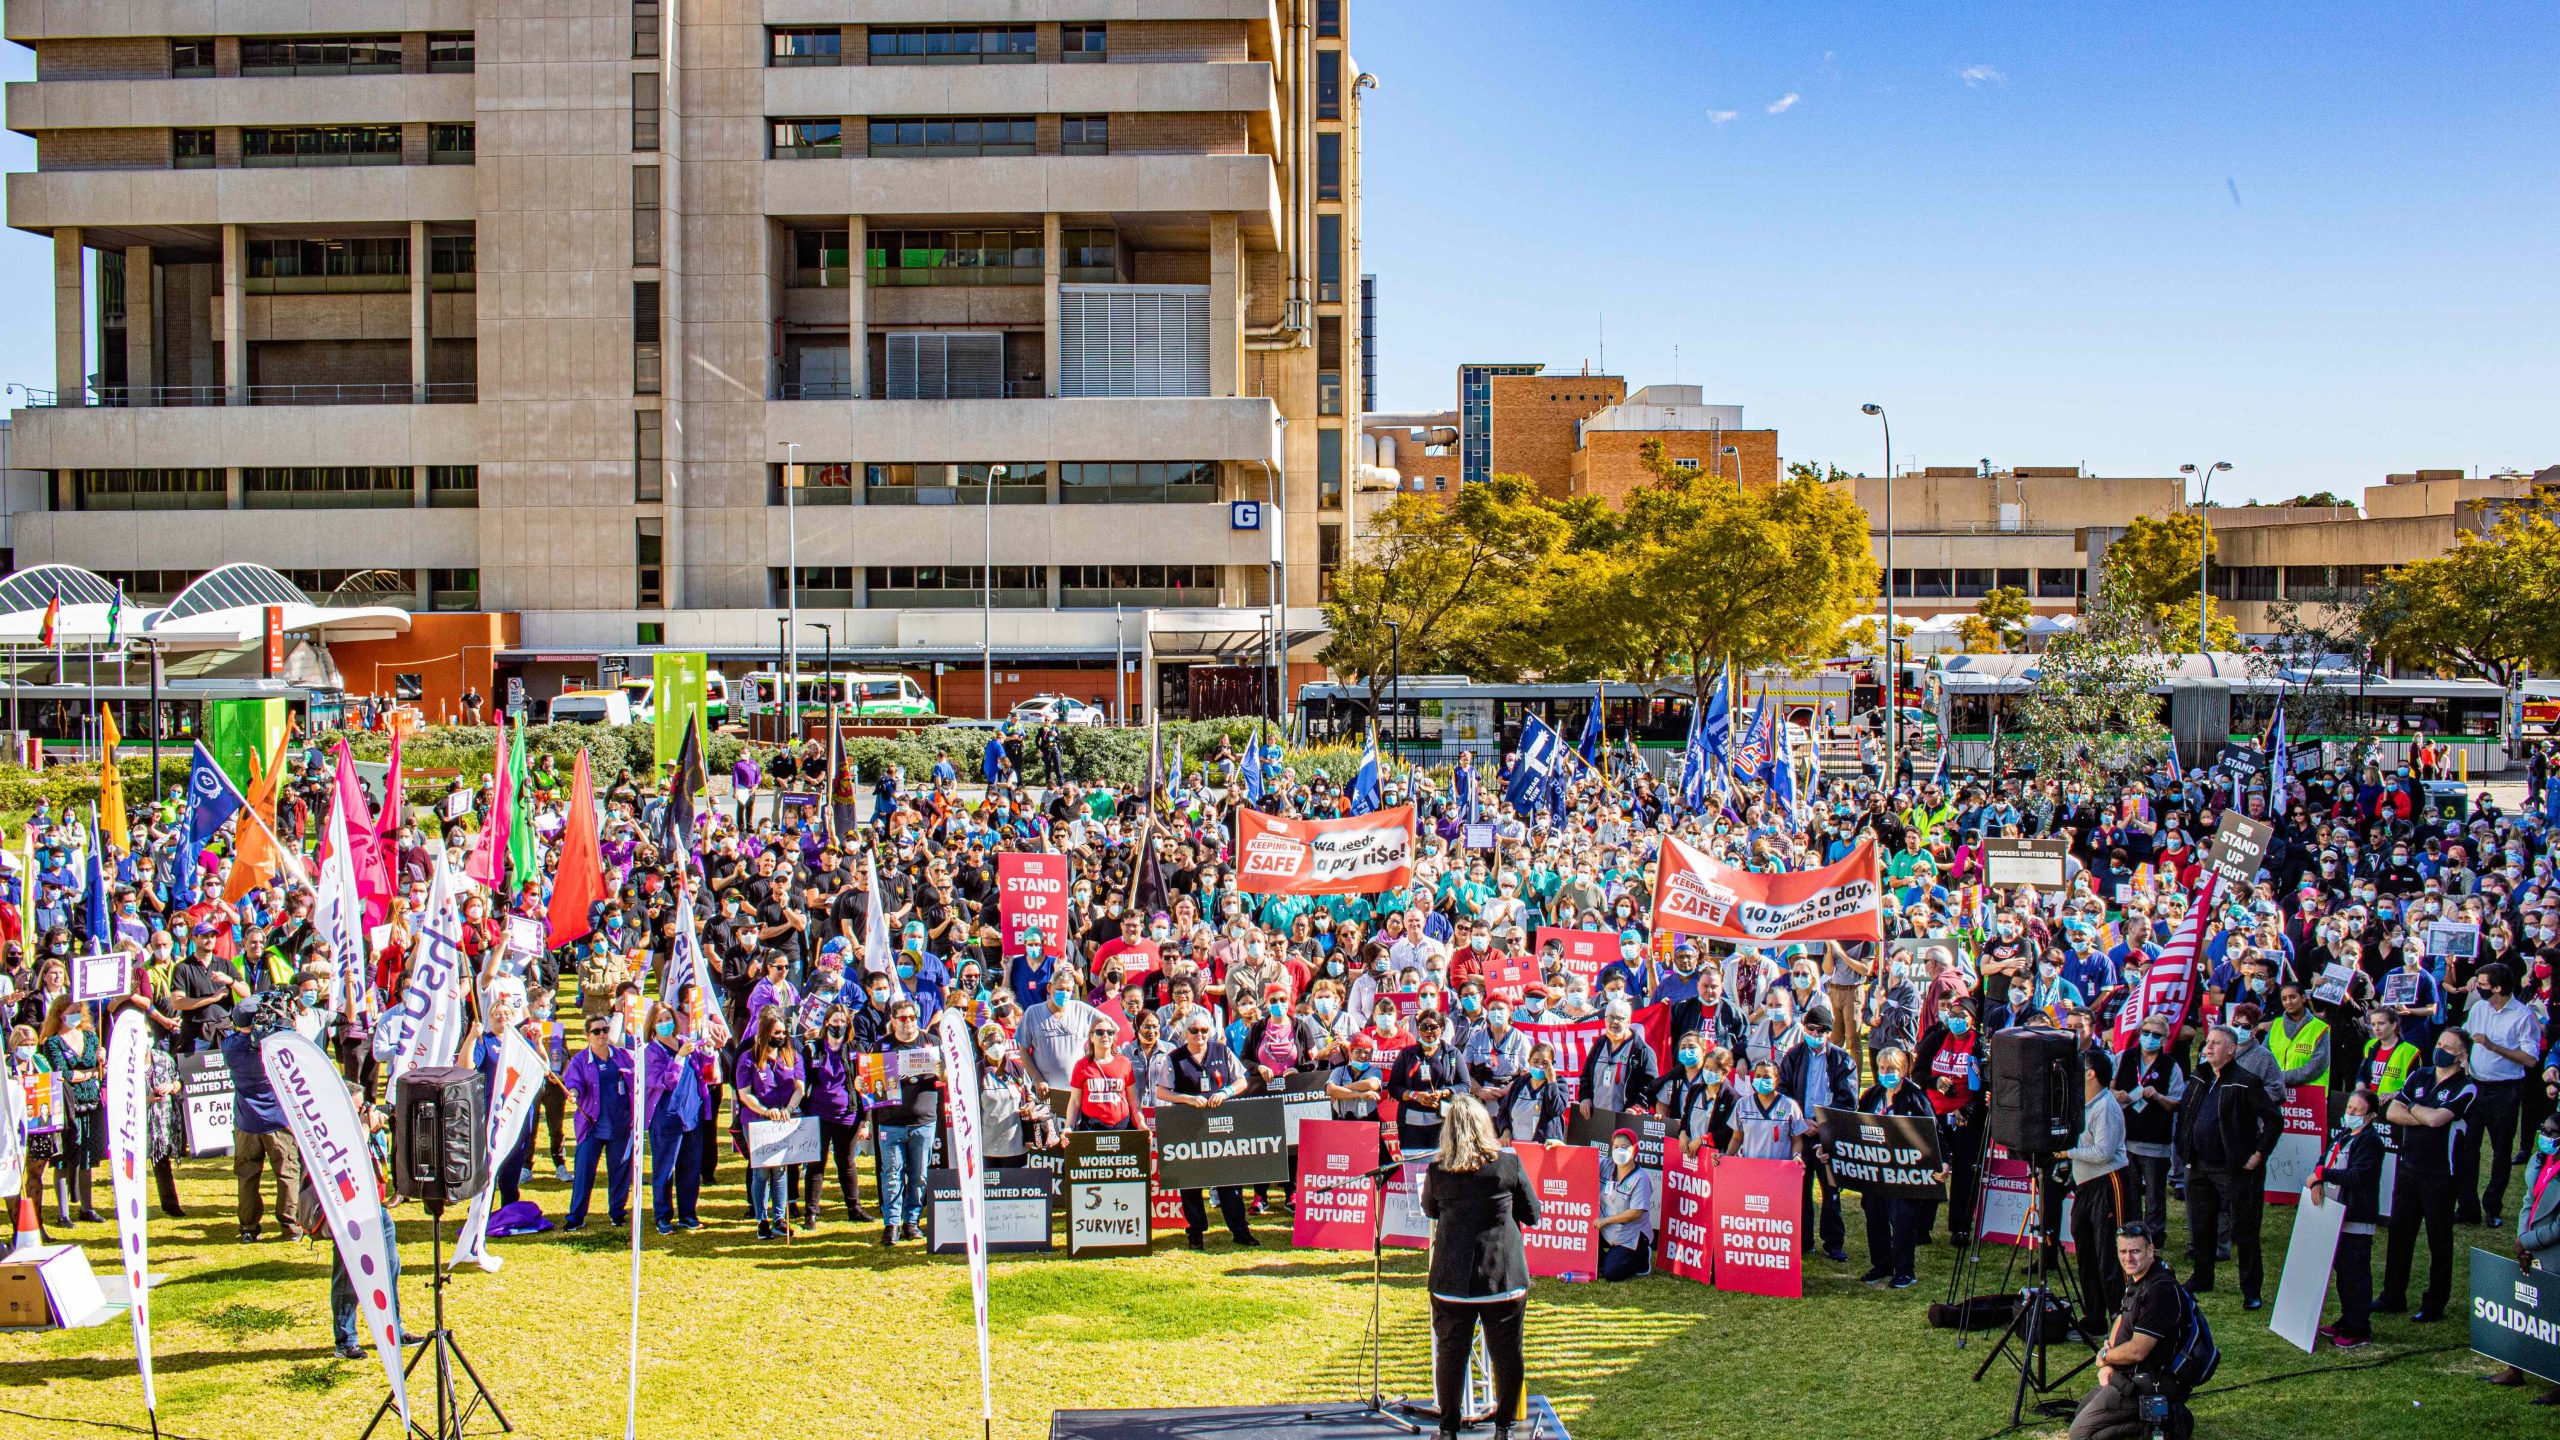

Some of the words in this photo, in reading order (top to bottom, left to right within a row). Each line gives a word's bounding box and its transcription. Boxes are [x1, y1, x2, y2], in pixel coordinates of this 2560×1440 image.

[1235, 504, 1257, 527] G
[2224, 757, 2256, 775] STAND
[1251, 840, 1287, 851] KEEPING
[1314, 841, 1335, 852] WA
[2220, 830, 2260, 857] STAND
[1317, 858, 1326, 871] a
[1363, 842, 1406, 866] ri$e!
[1988, 850, 2020, 858] WORKERS
[2226, 848, 2244, 865] UP
[1024, 861, 1043, 869] UNITED
[1250, 855, 1296, 873] SAFE
[2212, 859, 2249, 882] FIGHT
[1007, 877, 1060, 893] STAND
[1672, 876, 1711, 898] KEEPING
[1024, 895, 1046, 909] UP
[1669, 892, 1721, 922] SAFE
[1745, 905, 1766, 921] 10
[1819, 896, 1829, 906] a
[1012, 913, 1058, 928] FIGHT
[1756, 923, 1778, 934] not
[1780, 914, 1814, 931] much
[1818, 908, 1830, 919] to
[1015, 931, 1056, 947] BCK
[1118, 953, 1150, 963] UNITED
[1492, 984, 1524, 1001] STAN
[1371, 1049, 1400, 1062] NITE
[185, 1082, 220, 1094] UNITED
[1088, 1078, 1123, 1092] UNITED
[2285, 1089, 2297, 1098] TED
[209, 1101, 232, 1112] FAIR
[1208, 1117, 1234, 1127] UNITED
[1643, 1121, 1666, 1131] UNITED
[1860, 1125, 1885, 1136] UNITED
[1096, 1136, 1120, 1145] UNITED
[1163, 1136, 1282, 1161] SOLIDARITY
[1079, 1155, 1138, 1167] WORKERS
[1327, 1154, 1349, 1164] UNITED
[1835, 1141, 1891, 1164] STAND
[1895, 1149, 1922, 1165] UP
[1027, 1153, 1065, 1174] IGHT
[1070, 1168, 1113, 1180] UNITED
[1115, 1167, 1147, 1179] FOR..
[1832, 1158, 1879, 1182] FIGHT
[1882, 1167, 1937, 1186] BACK
[1304, 1174, 1371, 1190] FIGHTING
[1387, 1181, 1418, 1191] WORK
[1543, 1179, 1568, 1188] UNITED
[1668, 1171, 1711, 1199] STAND
[1988, 1178, 2028, 1191] ORKERS
[934, 1189, 962, 1199] WORK
[984, 1188, 1019, 1199] UNITED
[1021, 1187, 1048, 1198] FOR..
[1084, 1187, 1102, 1210] 5
[1113, 1198, 1129, 1212] to
[1305, 1192, 1333, 1205] FOR
[1336, 1193, 1368, 1207] OUR
[1745, 1195, 1769, 1205] UNITED
[1305, 1208, 1365, 1223] FUTURE!
[1540, 1200, 1592, 1217] GHTING
[1679, 1197, 1698, 1218] UP
[1076, 1218, 1140, 1237] SURVIVE!
[1555, 1218, 1589, 1234] OUR
[1667, 1217, 1707, 1245] FIGHT
[1720, 1215, 1793, 1234] FIGHTING
[1522, 1233, 1587, 1252] FUTURE!
[1723, 1233, 1754, 1249] FOR
[1757, 1236, 1791, 1252] OUR
[1666, 1241, 1702, 1269] BACK
[1725, 1250, 1790, 1270] FUTURE!
